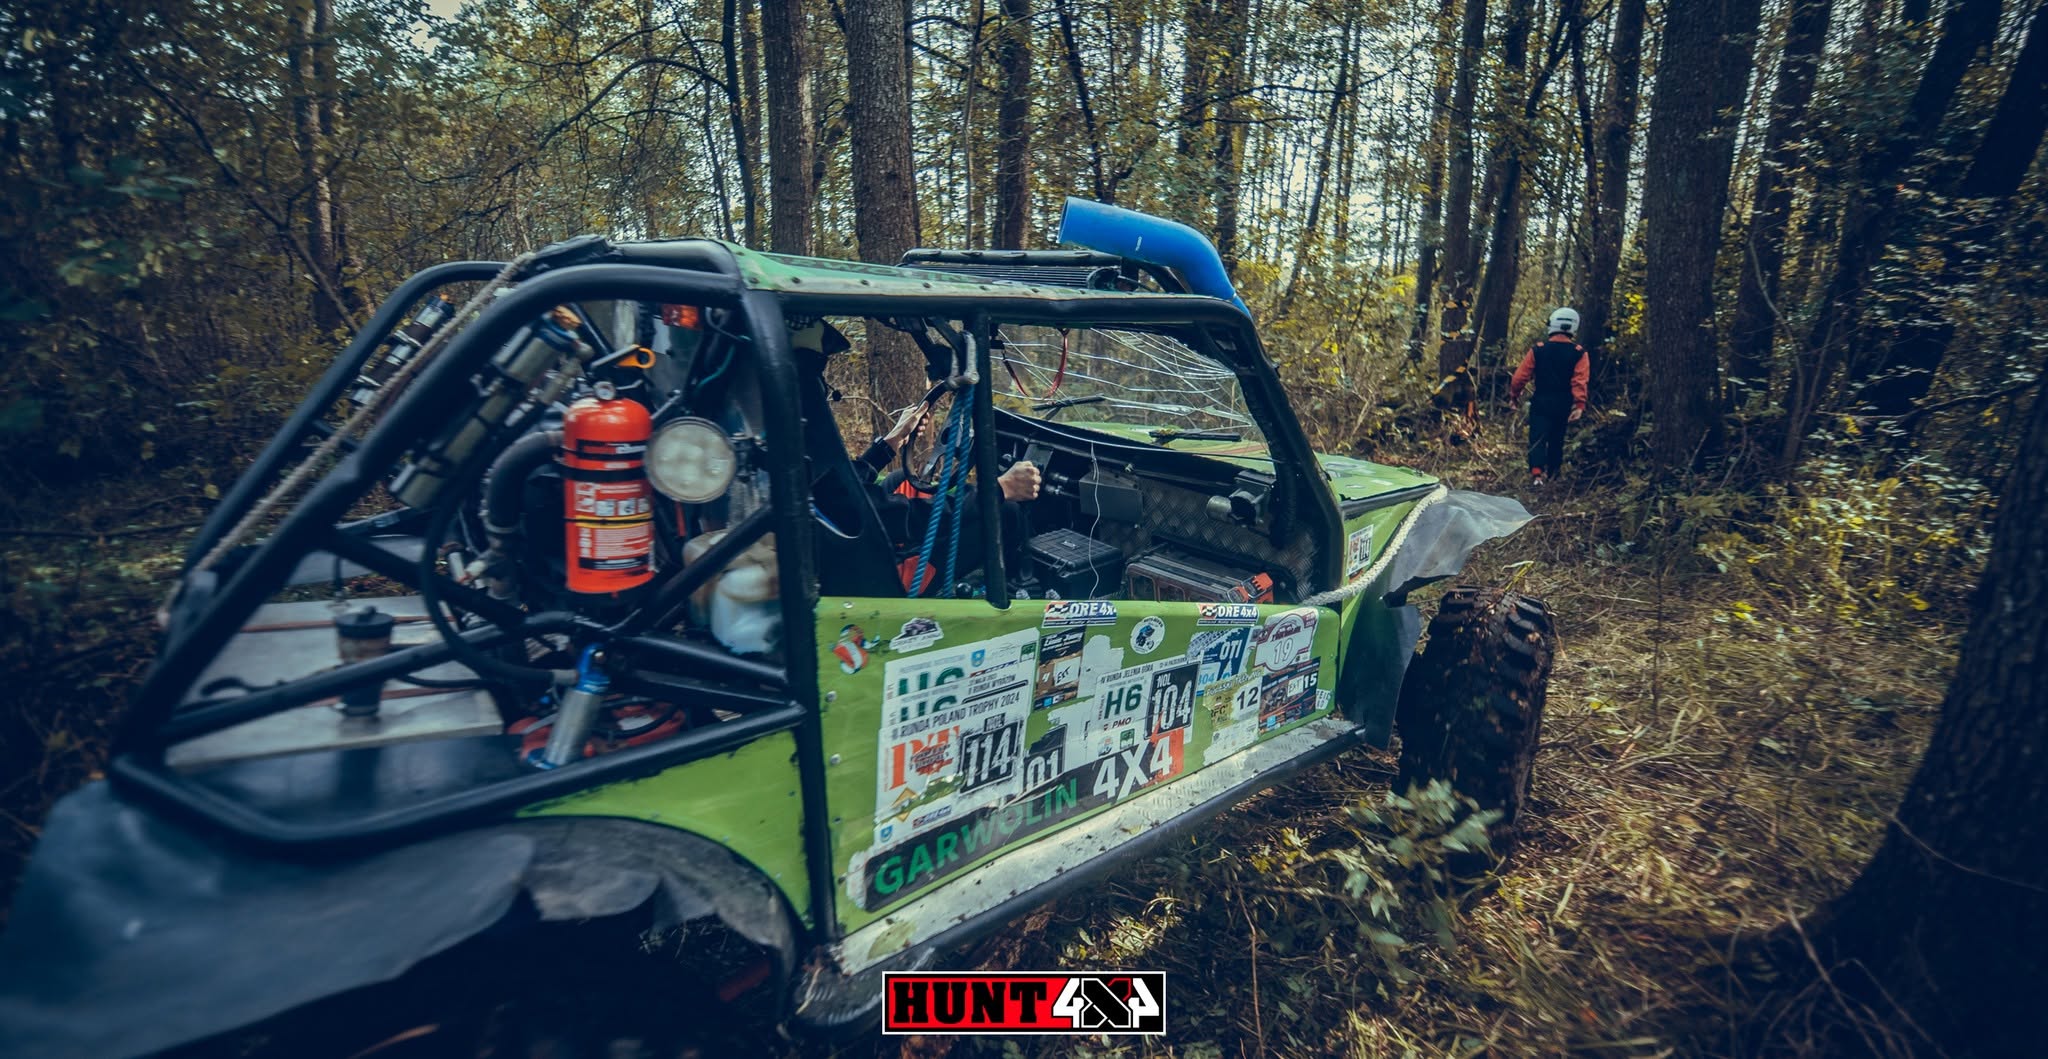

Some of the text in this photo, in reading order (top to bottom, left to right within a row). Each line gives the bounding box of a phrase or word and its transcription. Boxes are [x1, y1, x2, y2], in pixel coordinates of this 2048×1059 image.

[1274, 638, 1294, 664] 19
[1157, 672, 1171, 688] NOL
[1304, 672, 1318, 689] 15
[932, 707, 967, 728] POLAND
[968, 699, 999, 717] TROPHY
[1000, 691, 1020, 708] 2024
[1104, 683, 1143, 719] H6
[1152, 680, 1193, 733] 104
[1237, 686, 1259, 711] 12
[1112, 716, 1132, 730] PMO
[966, 727, 1014, 788] 114
[874, 734, 1173, 895] GARWOLIN 4X4
